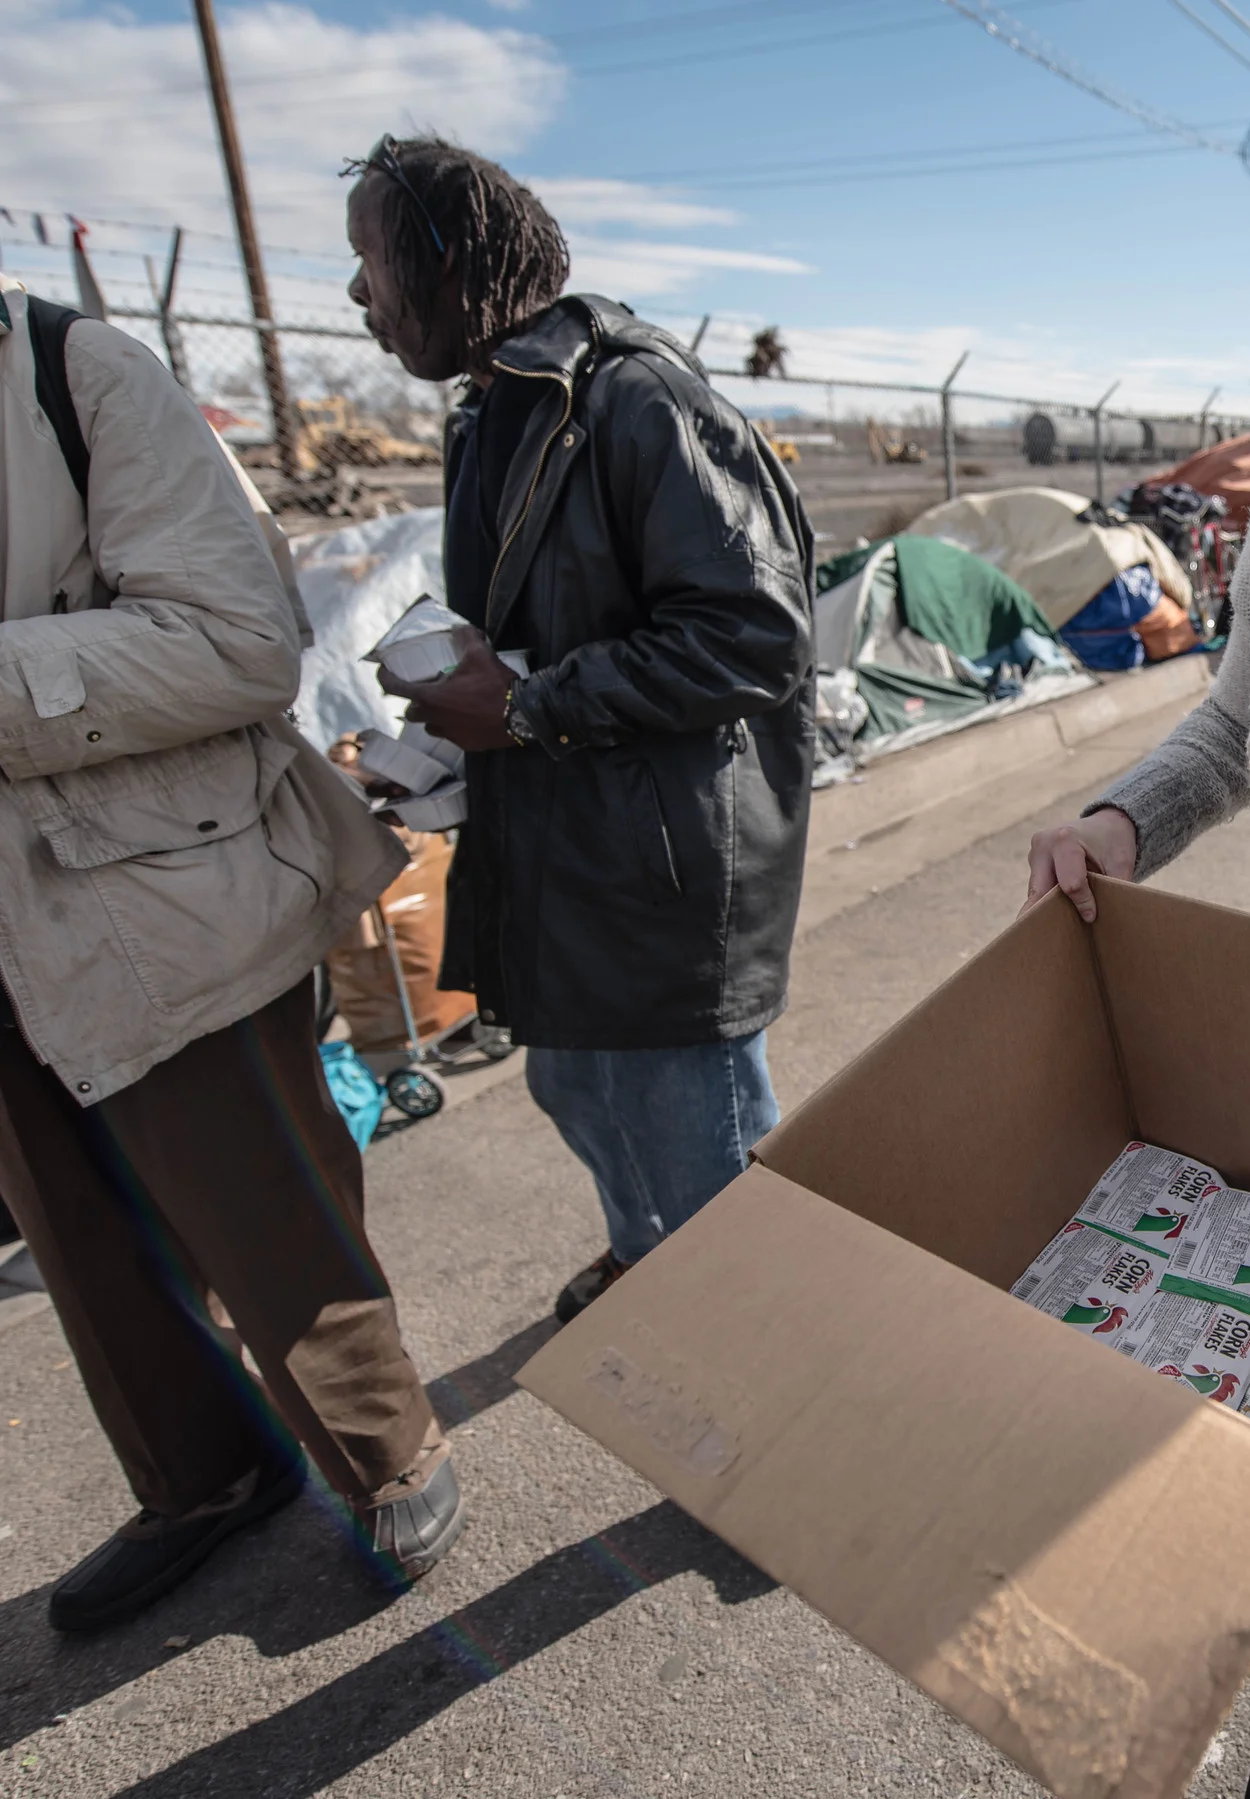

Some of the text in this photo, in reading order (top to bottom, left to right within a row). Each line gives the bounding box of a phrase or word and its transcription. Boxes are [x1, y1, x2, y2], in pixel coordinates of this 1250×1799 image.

[1168, 1166, 1198, 1196] FLAKES
[1181, 1172, 1211, 1203] CORN
[1102, 1252, 1136, 1288] FLAKES
[1115, 1259, 1150, 1294] CORN
[1132, 1269, 1154, 1294] Kellogg's
[1205, 1313, 1235, 1351] FLAKES
[1220, 1320, 1250, 1358] CORN
